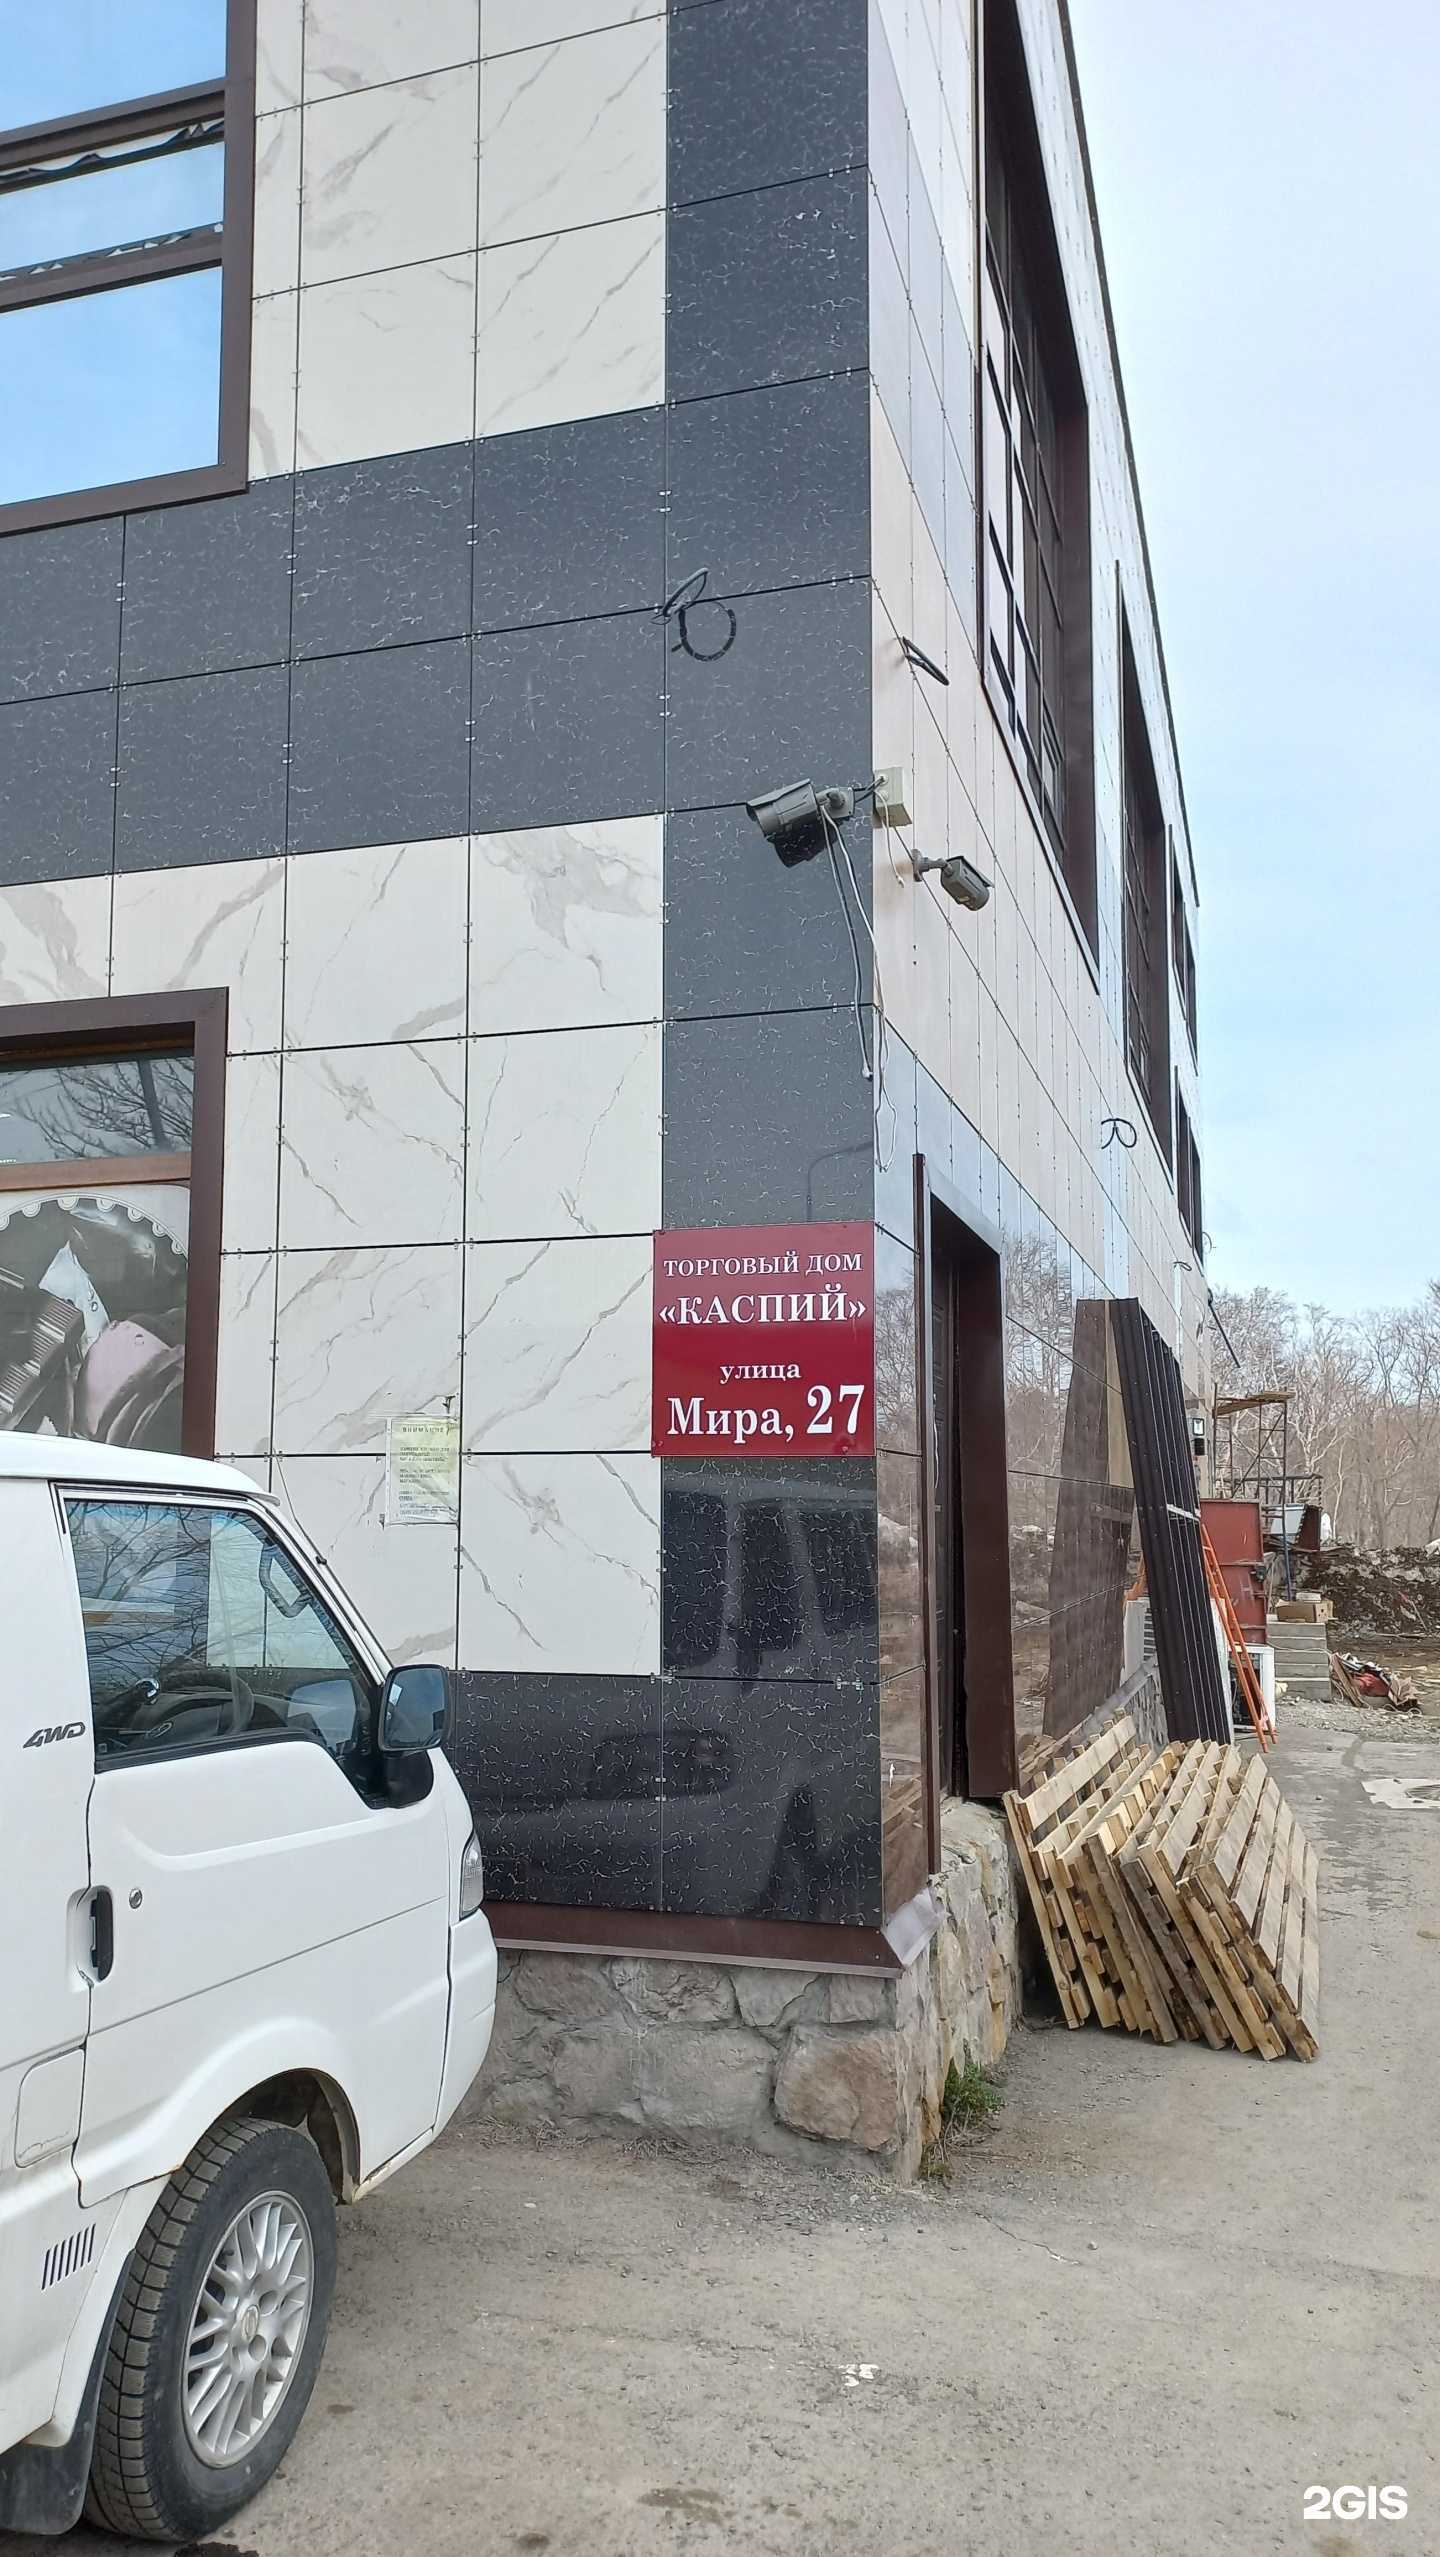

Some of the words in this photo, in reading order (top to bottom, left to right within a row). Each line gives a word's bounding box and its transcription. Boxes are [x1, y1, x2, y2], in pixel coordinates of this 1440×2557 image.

[664, 1250, 800, 1277] ТОРГОВЫЙ
[806, 1253, 862, 1276] ДОМ
[659, 1283, 867, 1325] «КАСПИЙ»
[720, 1363, 801, 1384] улица
[667, 1397, 794, 1443] Мира,
[806, 1384, 865, 1434] 27
[22, 1721, 86, 1748] 4WD
